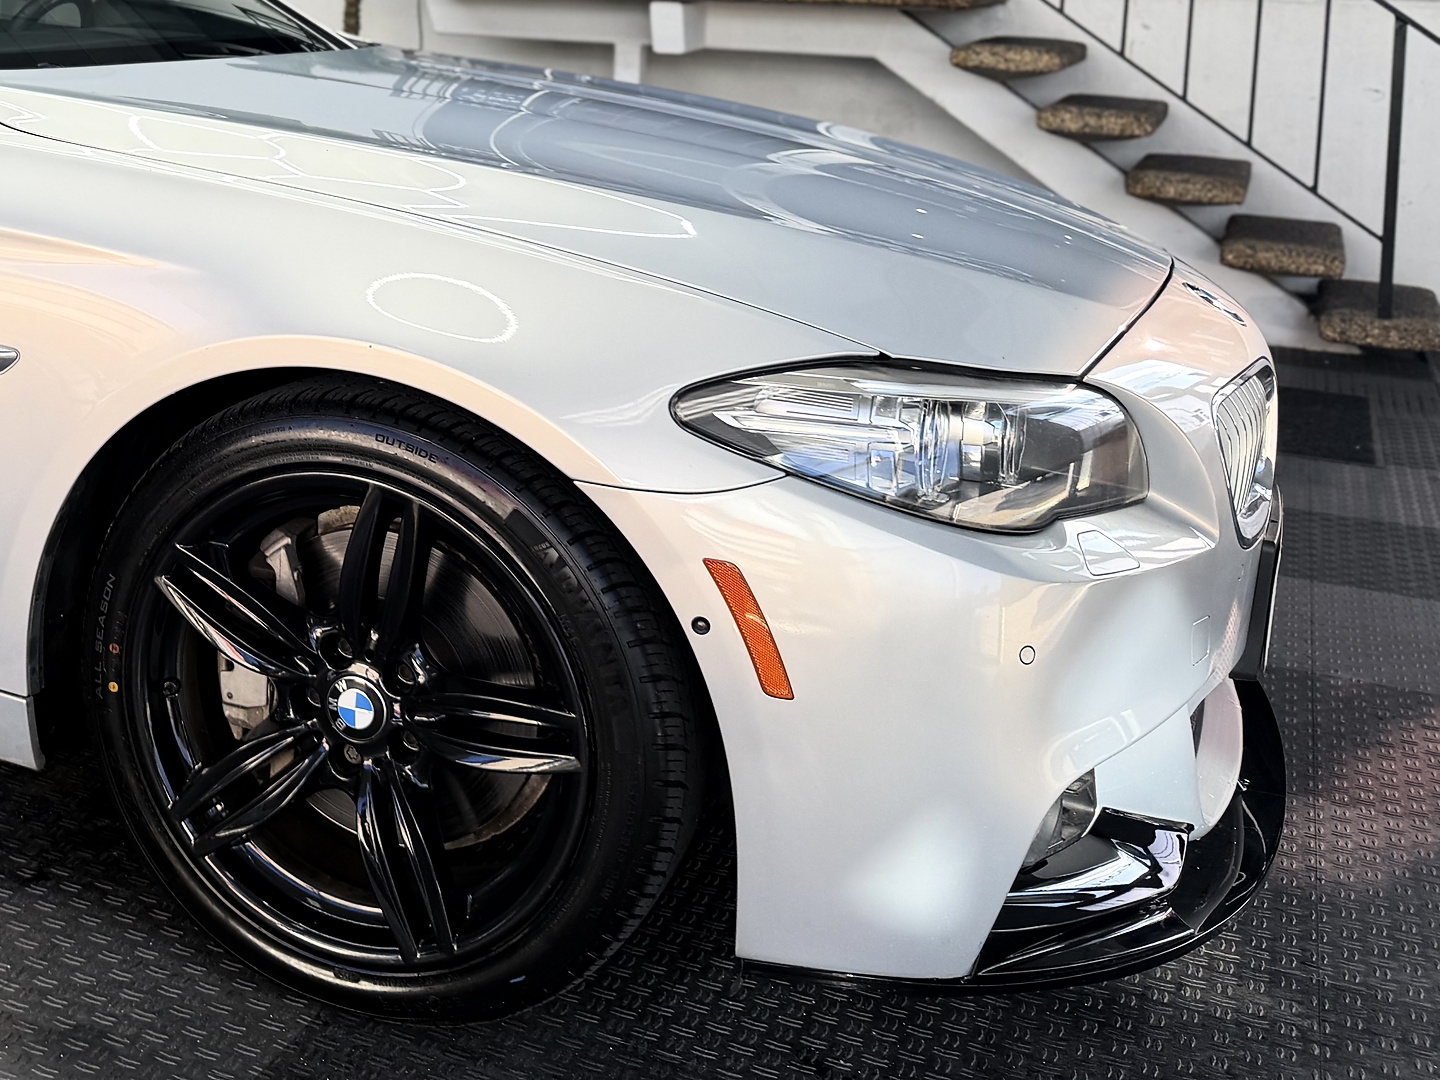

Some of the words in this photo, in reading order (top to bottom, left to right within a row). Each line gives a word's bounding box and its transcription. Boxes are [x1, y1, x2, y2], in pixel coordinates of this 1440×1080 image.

[375, 433, 439, 463] OUTSIDE
[94, 573, 117, 654] SEASON
[93, 660, 104, 700] ALL
[328, 679, 348, 731] BMW
